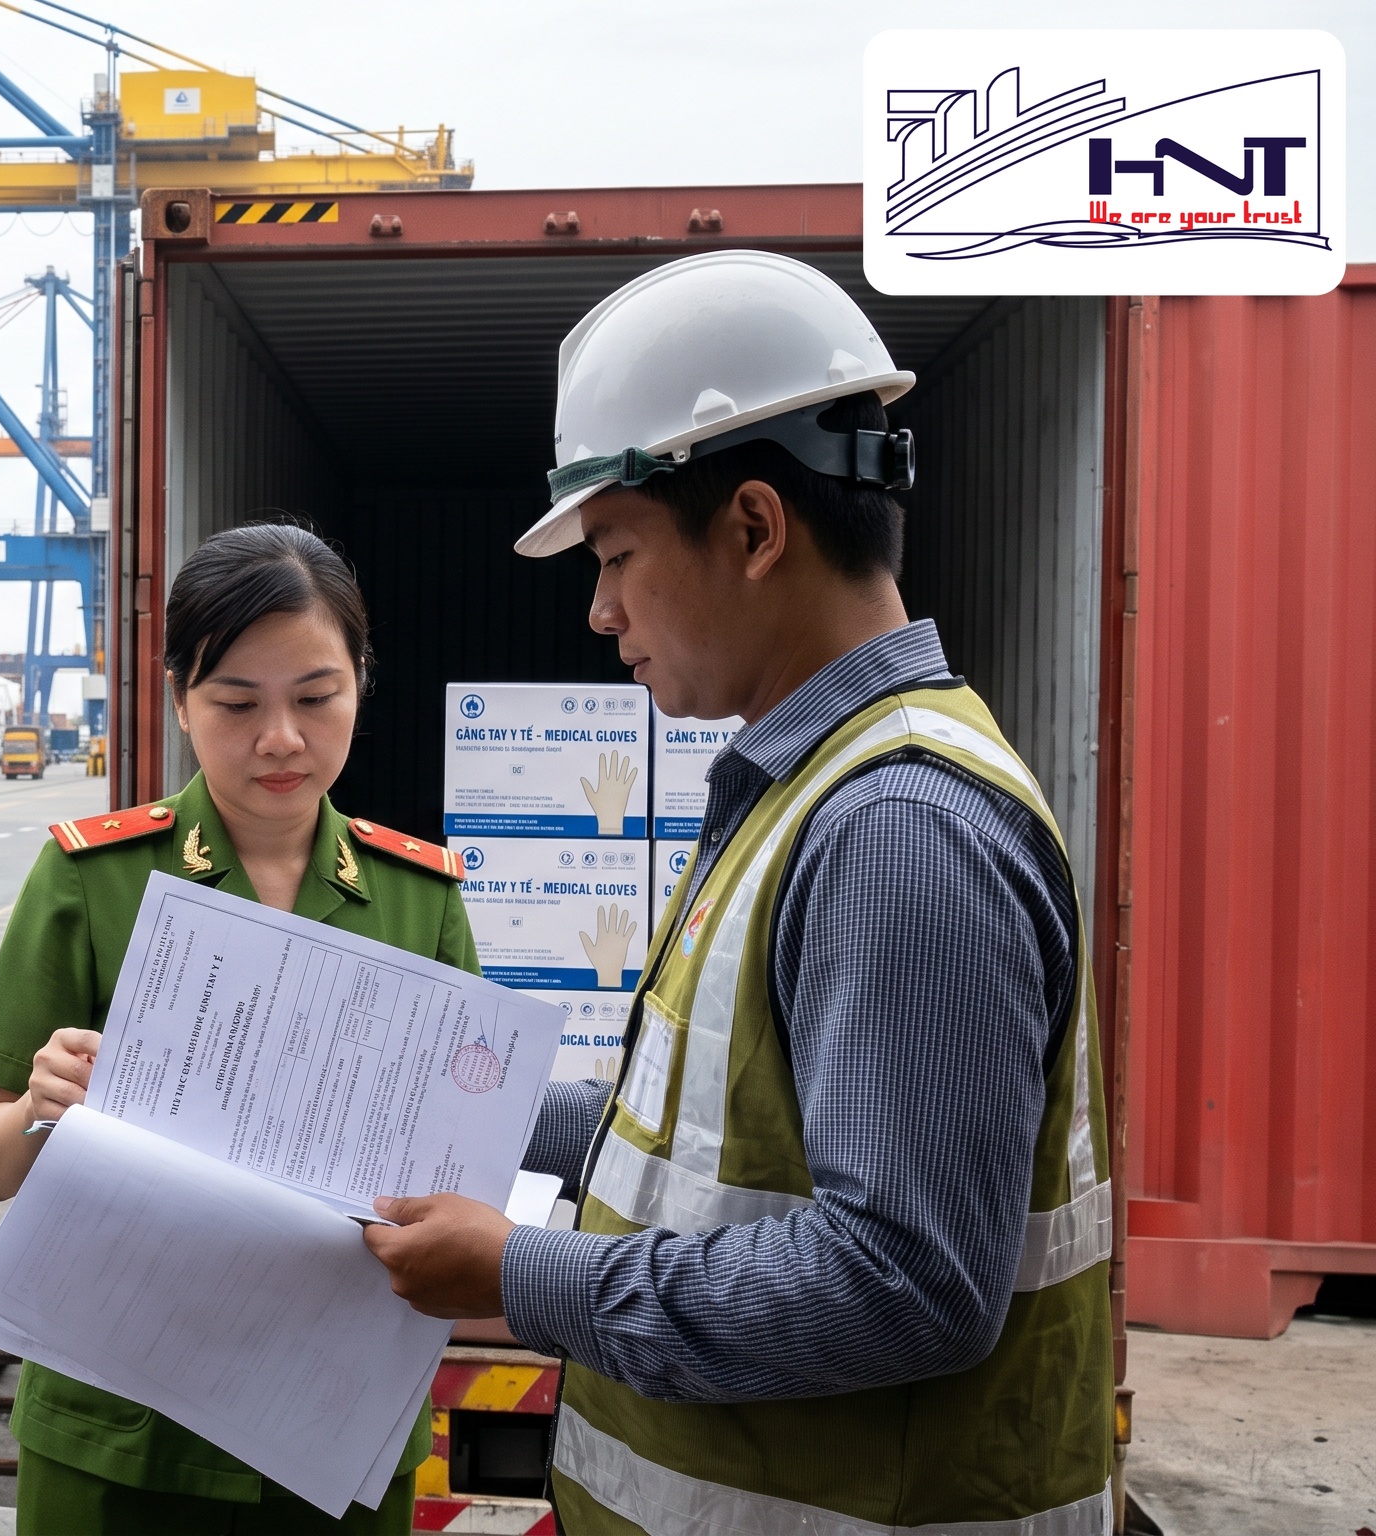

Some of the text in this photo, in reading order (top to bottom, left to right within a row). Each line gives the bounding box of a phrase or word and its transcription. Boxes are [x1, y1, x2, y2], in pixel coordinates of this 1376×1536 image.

[488, 728, 507, 740] TAY
[510, 728, 517, 740] Y
[544, 729, 593, 742] MEDICAL
[596, 730, 637, 742] GLOVES
[699, 731, 719, 743] TAY
[488, 880, 507, 892] TAY
[510, 881, 517, 893] Y
[543, 882, 592, 895] MEDICAL
[595, 883, 637, 896] GLOVES
[560, 1034, 622, 1047] DICAL GLOV
